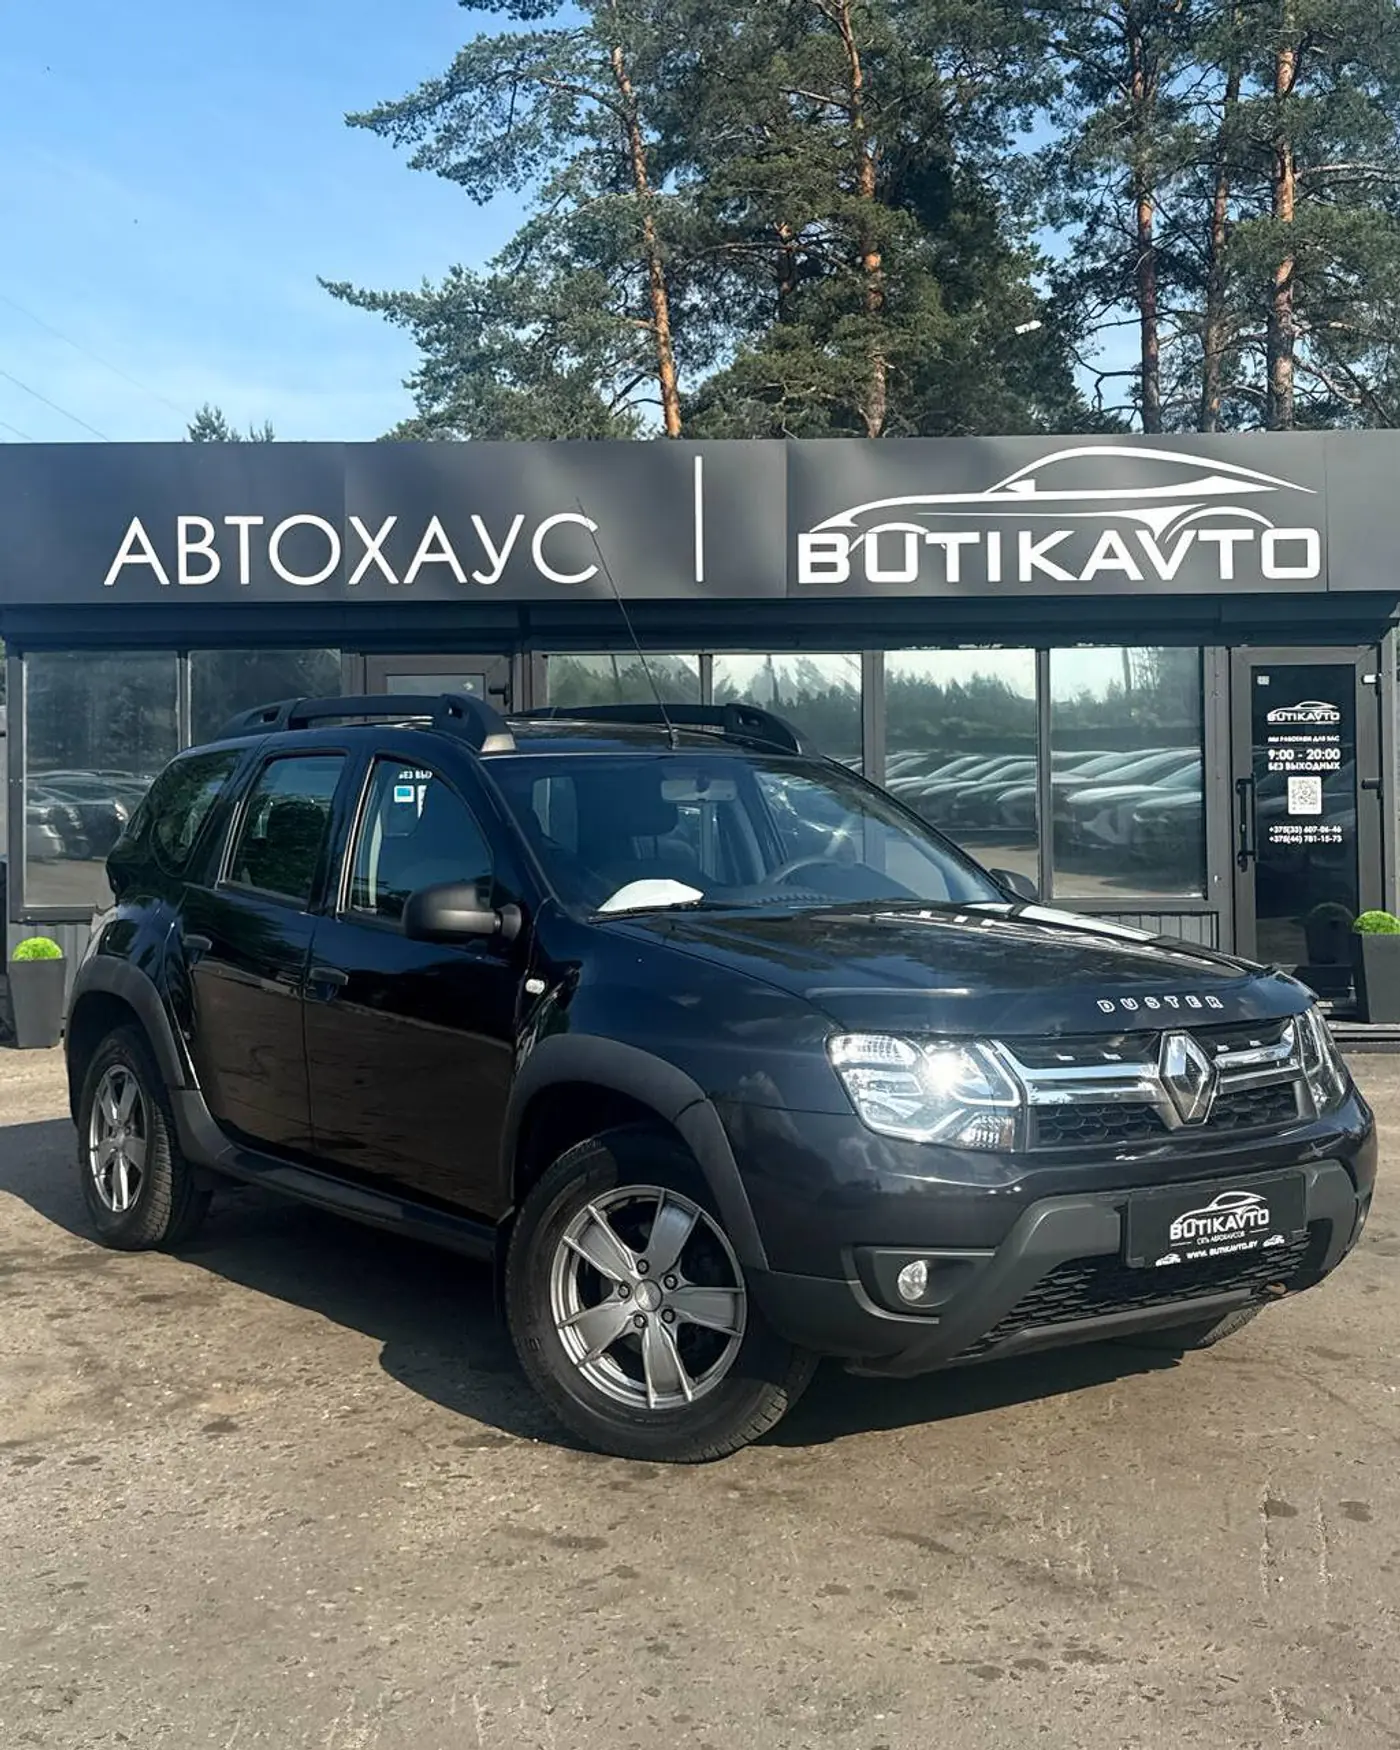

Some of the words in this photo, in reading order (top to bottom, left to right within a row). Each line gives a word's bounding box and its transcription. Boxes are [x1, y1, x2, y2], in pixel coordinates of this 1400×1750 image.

[103, 513, 601, 586] АВТОХАУС
[797, 526, 1322, 585] BUTIKAVTO
[1267, 711, 1340, 722] BUTIKAVTO
[1268, 749, 1294, 760] 9:00
[1306, 748, 1341, 760] 20:00
[1268, 762, 1284, 770] БЕЗ
[1285, 762, 1340, 770] ВЫХОДНЫХ
[1097, 995, 1224, 1012] DUSTER
[1170, 1208, 1269, 1240] BUTIKAVTO
